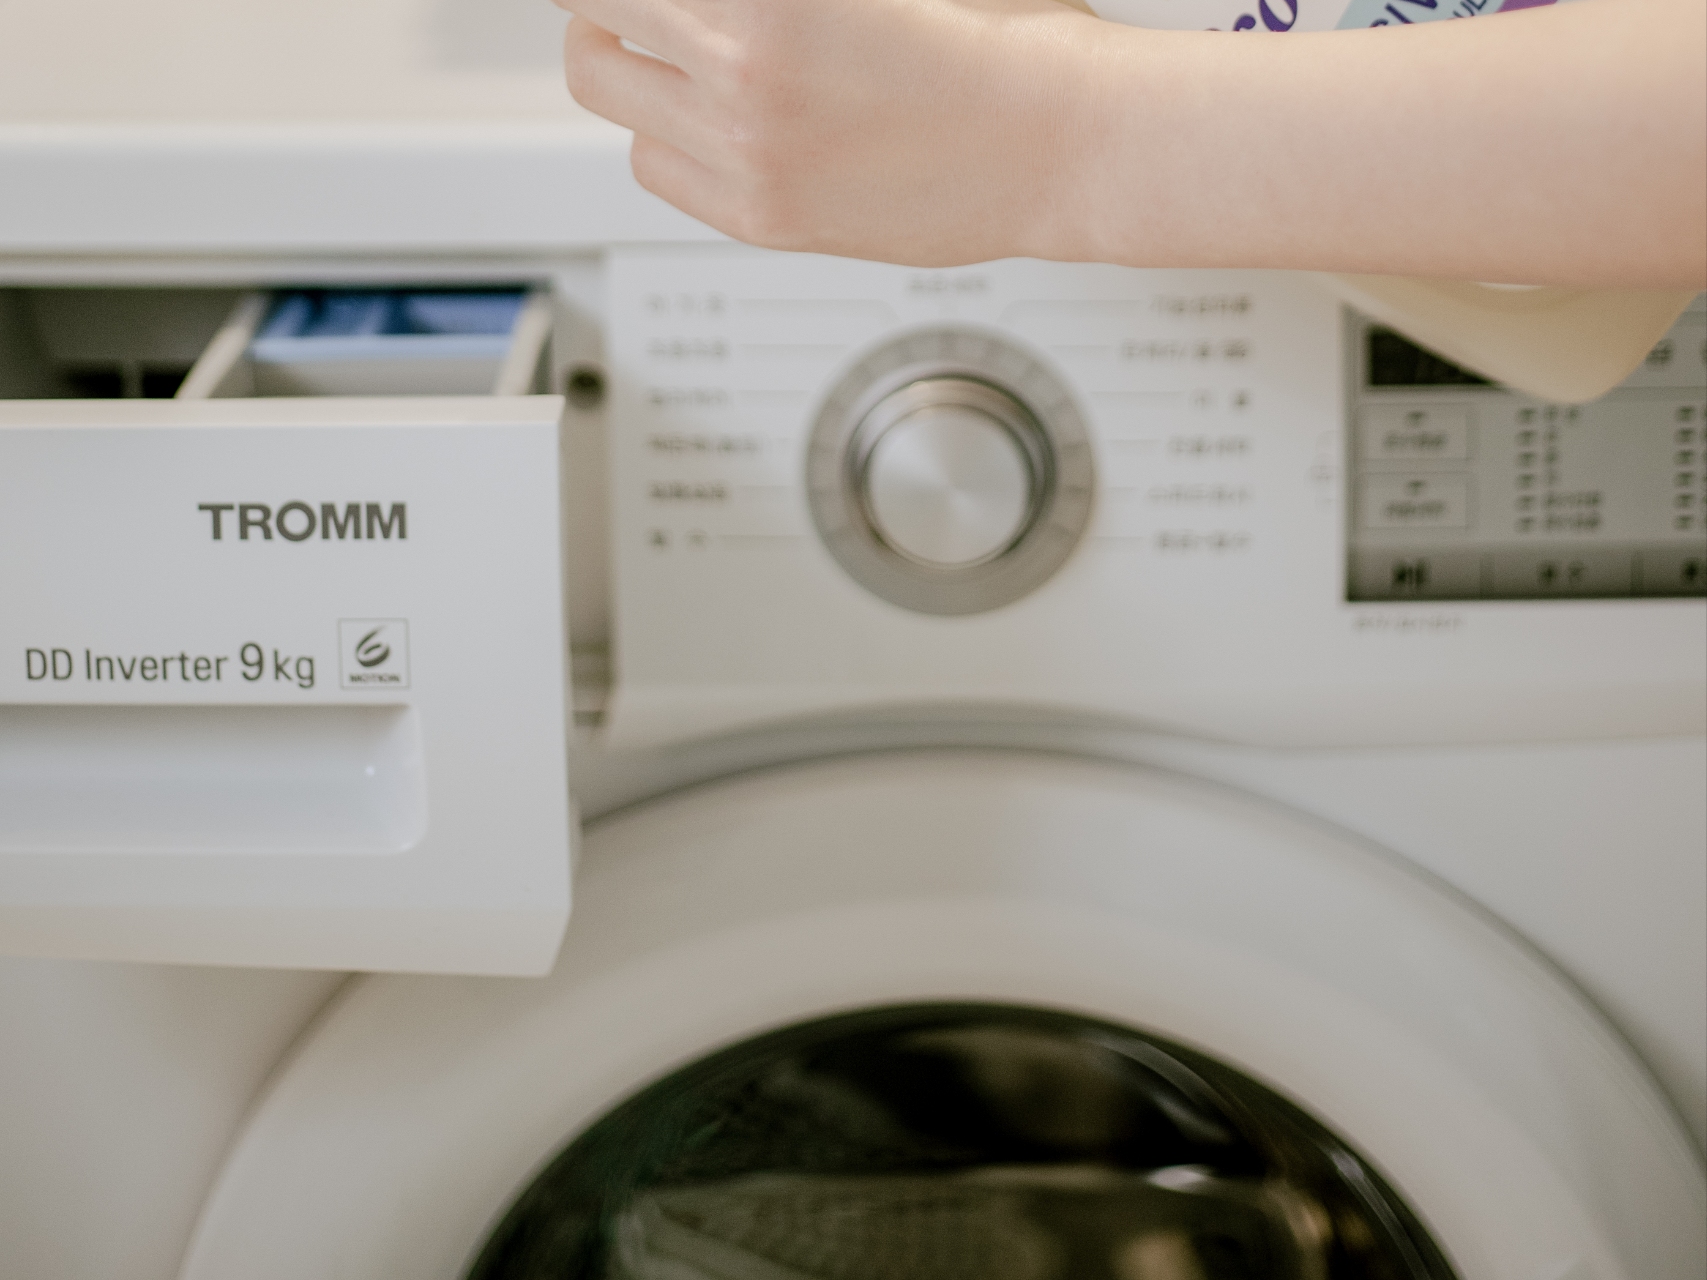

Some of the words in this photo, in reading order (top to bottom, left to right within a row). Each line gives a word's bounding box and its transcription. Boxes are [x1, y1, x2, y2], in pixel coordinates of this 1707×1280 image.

[198, 499, 407, 541] TROMM
[25, 648, 73, 680] DD
[85, 649, 228, 681] Inverter
[240, 642, 264, 681] 9
[273, 649, 315, 688] kg
